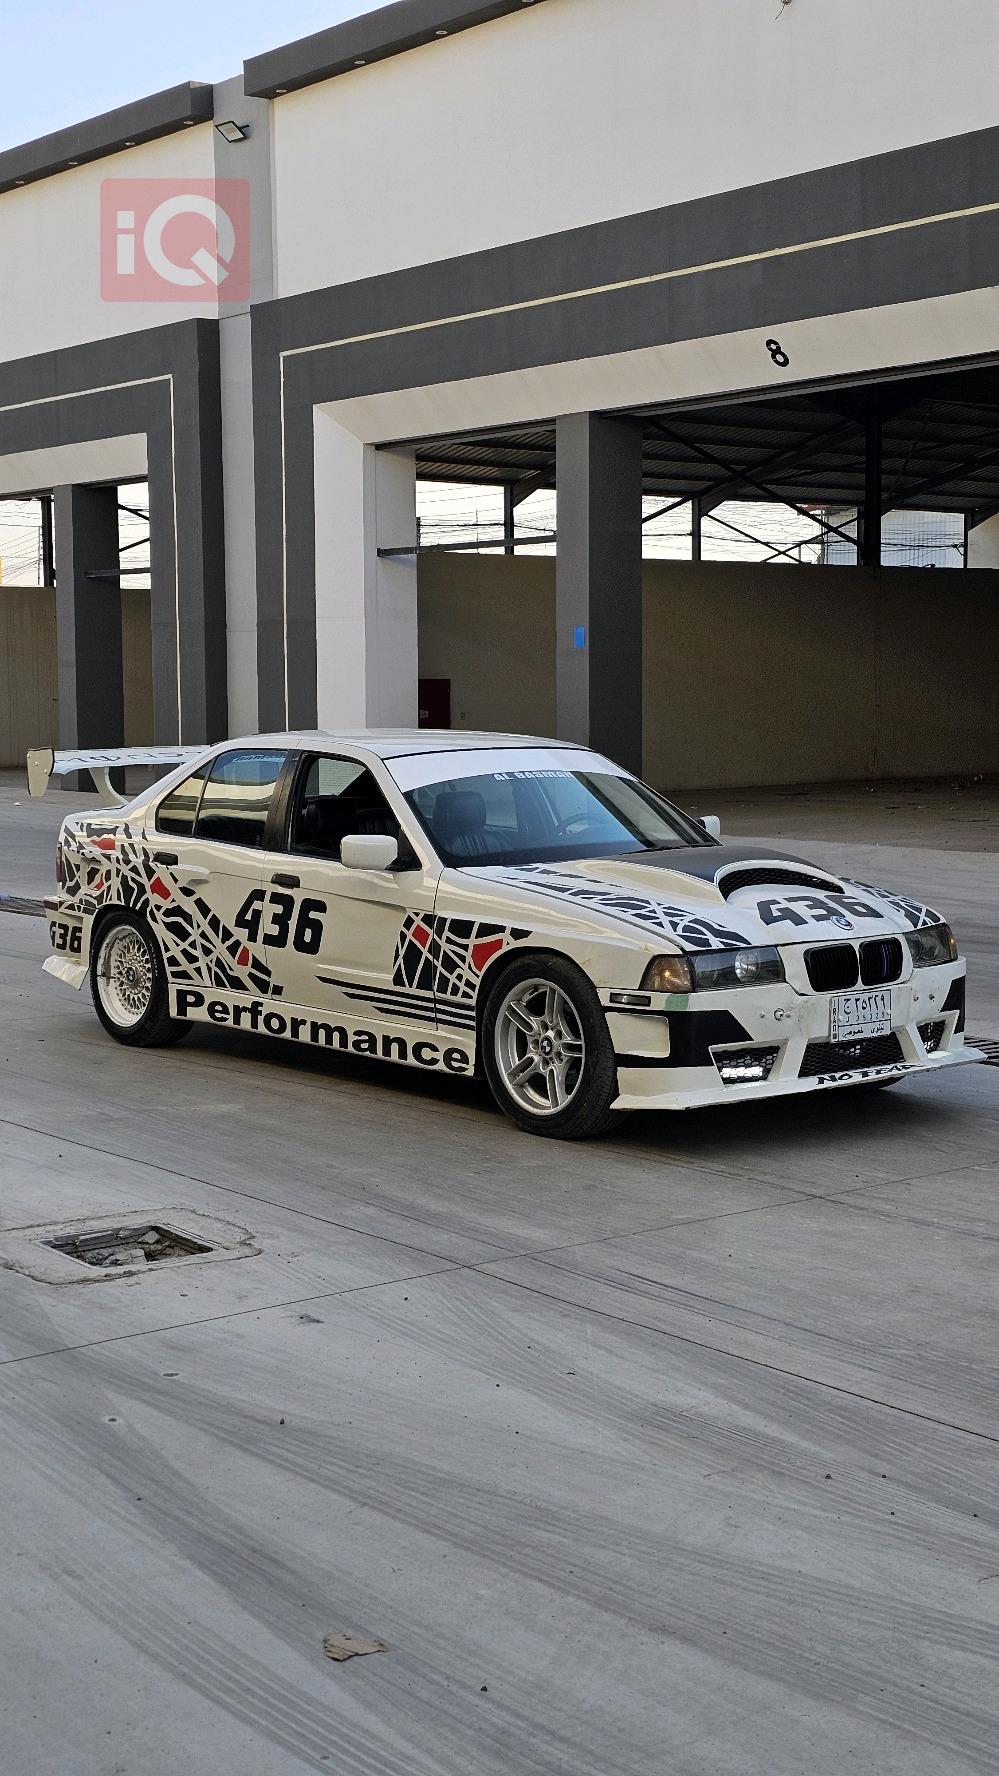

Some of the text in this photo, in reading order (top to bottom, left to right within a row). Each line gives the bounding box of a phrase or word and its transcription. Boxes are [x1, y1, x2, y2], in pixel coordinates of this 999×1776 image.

[765, 338, 790, 368] 8
[493, 773, 514, 781] AL
[234, 887, 328, 956] 436
[756, 894, 885, 927] 436
[49, 920, 83, 954] 436
[176, 988, 470, 1074] Performance
